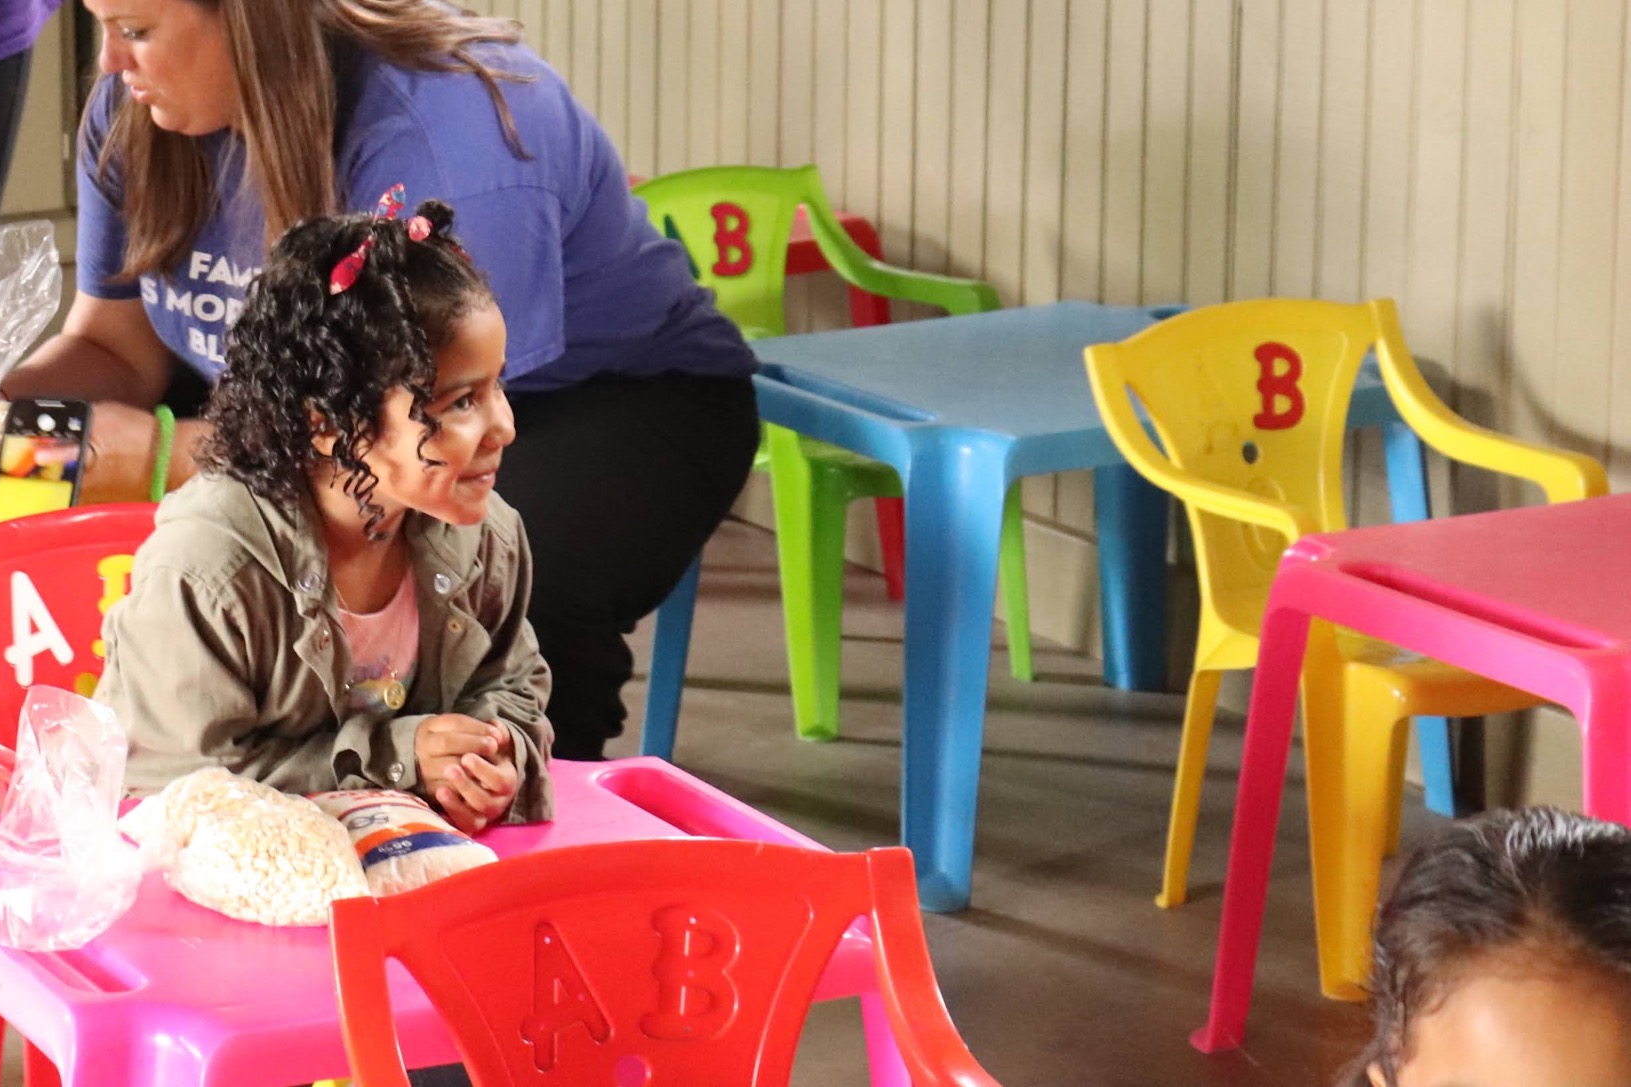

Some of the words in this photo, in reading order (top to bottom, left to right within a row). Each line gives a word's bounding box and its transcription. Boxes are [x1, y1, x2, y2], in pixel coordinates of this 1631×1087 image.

[710, 201, 754, 278] B
[139, 275, 159, 305] S
[1252, 341, 1306, 431] B
[4, 570, 75, 688] A
